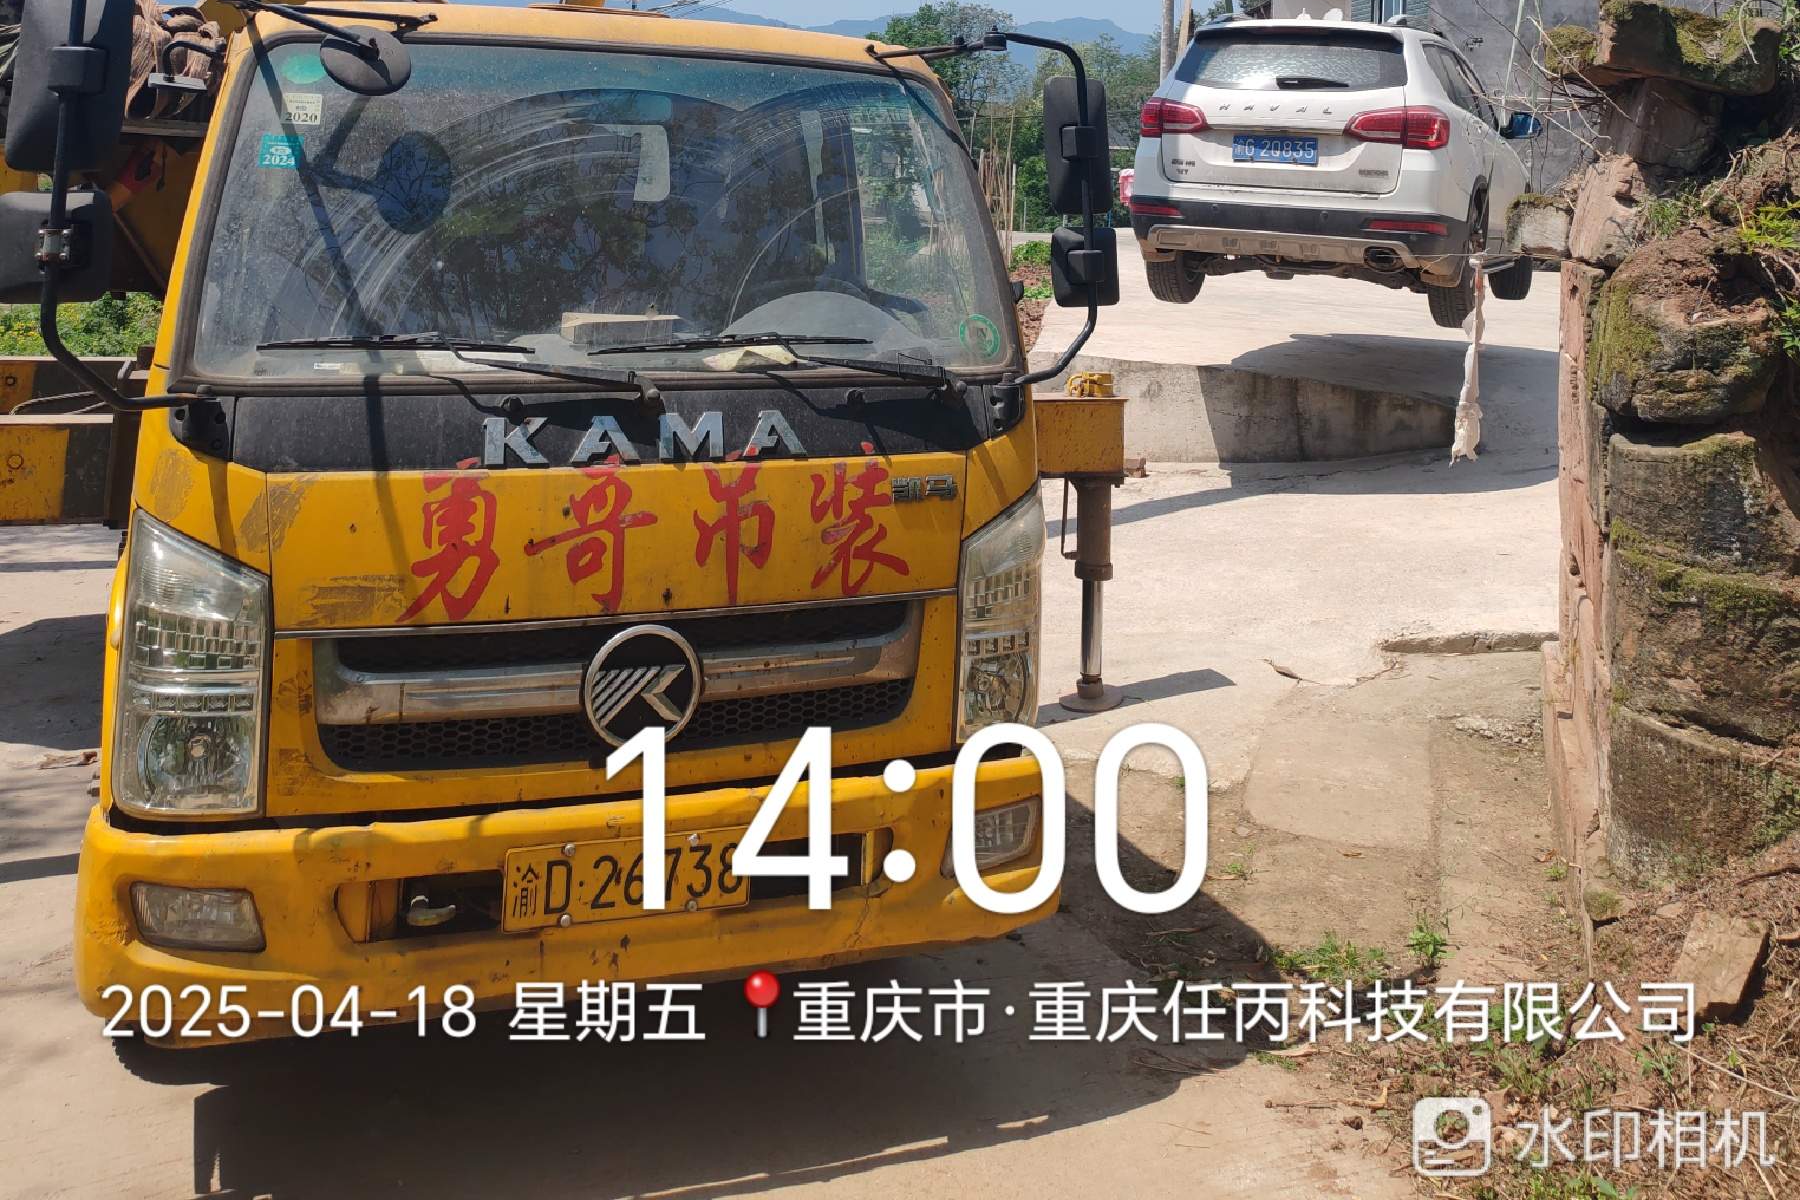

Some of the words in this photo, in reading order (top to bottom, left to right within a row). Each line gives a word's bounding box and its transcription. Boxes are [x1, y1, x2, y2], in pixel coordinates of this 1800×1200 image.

[482, 409, 808, 468] KAMA
[891, 474, 959, 502] 凯马
[395, 441, 910, 622] 勇哥吊装
